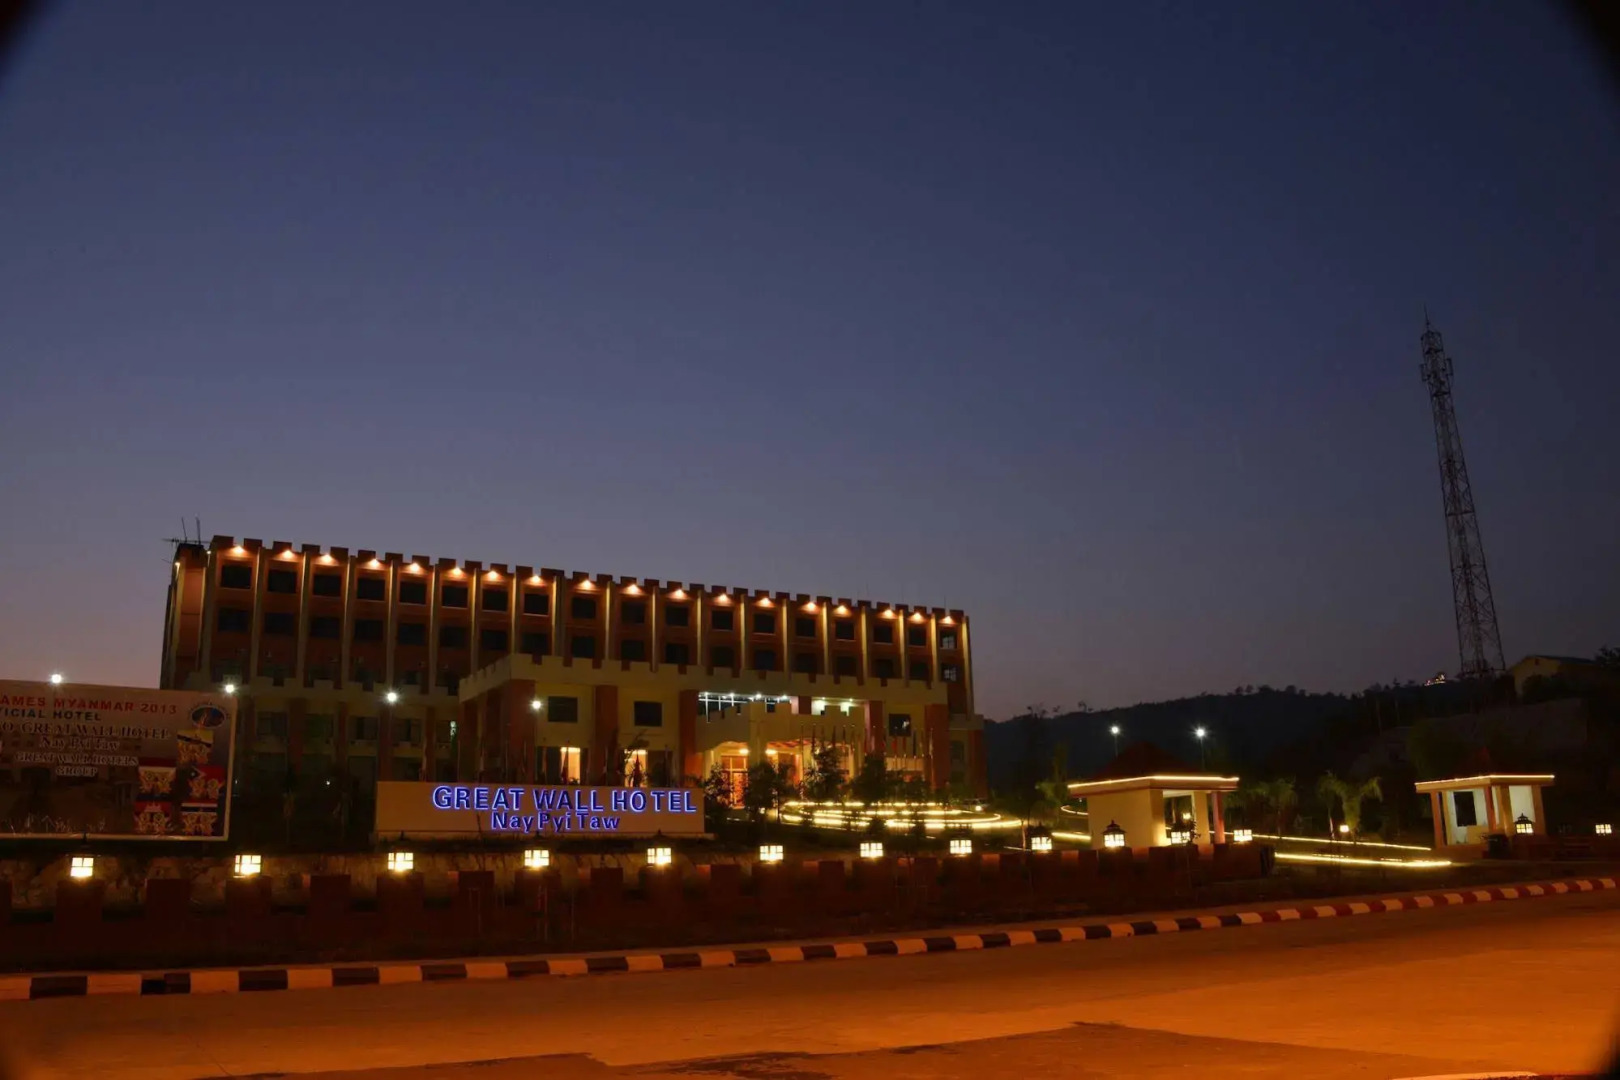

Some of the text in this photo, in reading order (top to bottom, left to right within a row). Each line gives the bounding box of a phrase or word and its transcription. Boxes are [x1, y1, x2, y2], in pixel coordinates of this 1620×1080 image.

[0, 707, 101, 721] ICIAL HOTEL
[54, 697, 134, 712] MYANMAR
[140, 703, 177, 715] 2013
[21, 722, 71, 736] GREAT
[76, 725, 117, 737] WALL
[121, 726, 169, 739] HOTEL
[15, 752, 54, 762] GREAT
[432, 785, 697, 812] GREAT WALL HOTEL
[491, 810, 534, 834] Nay
